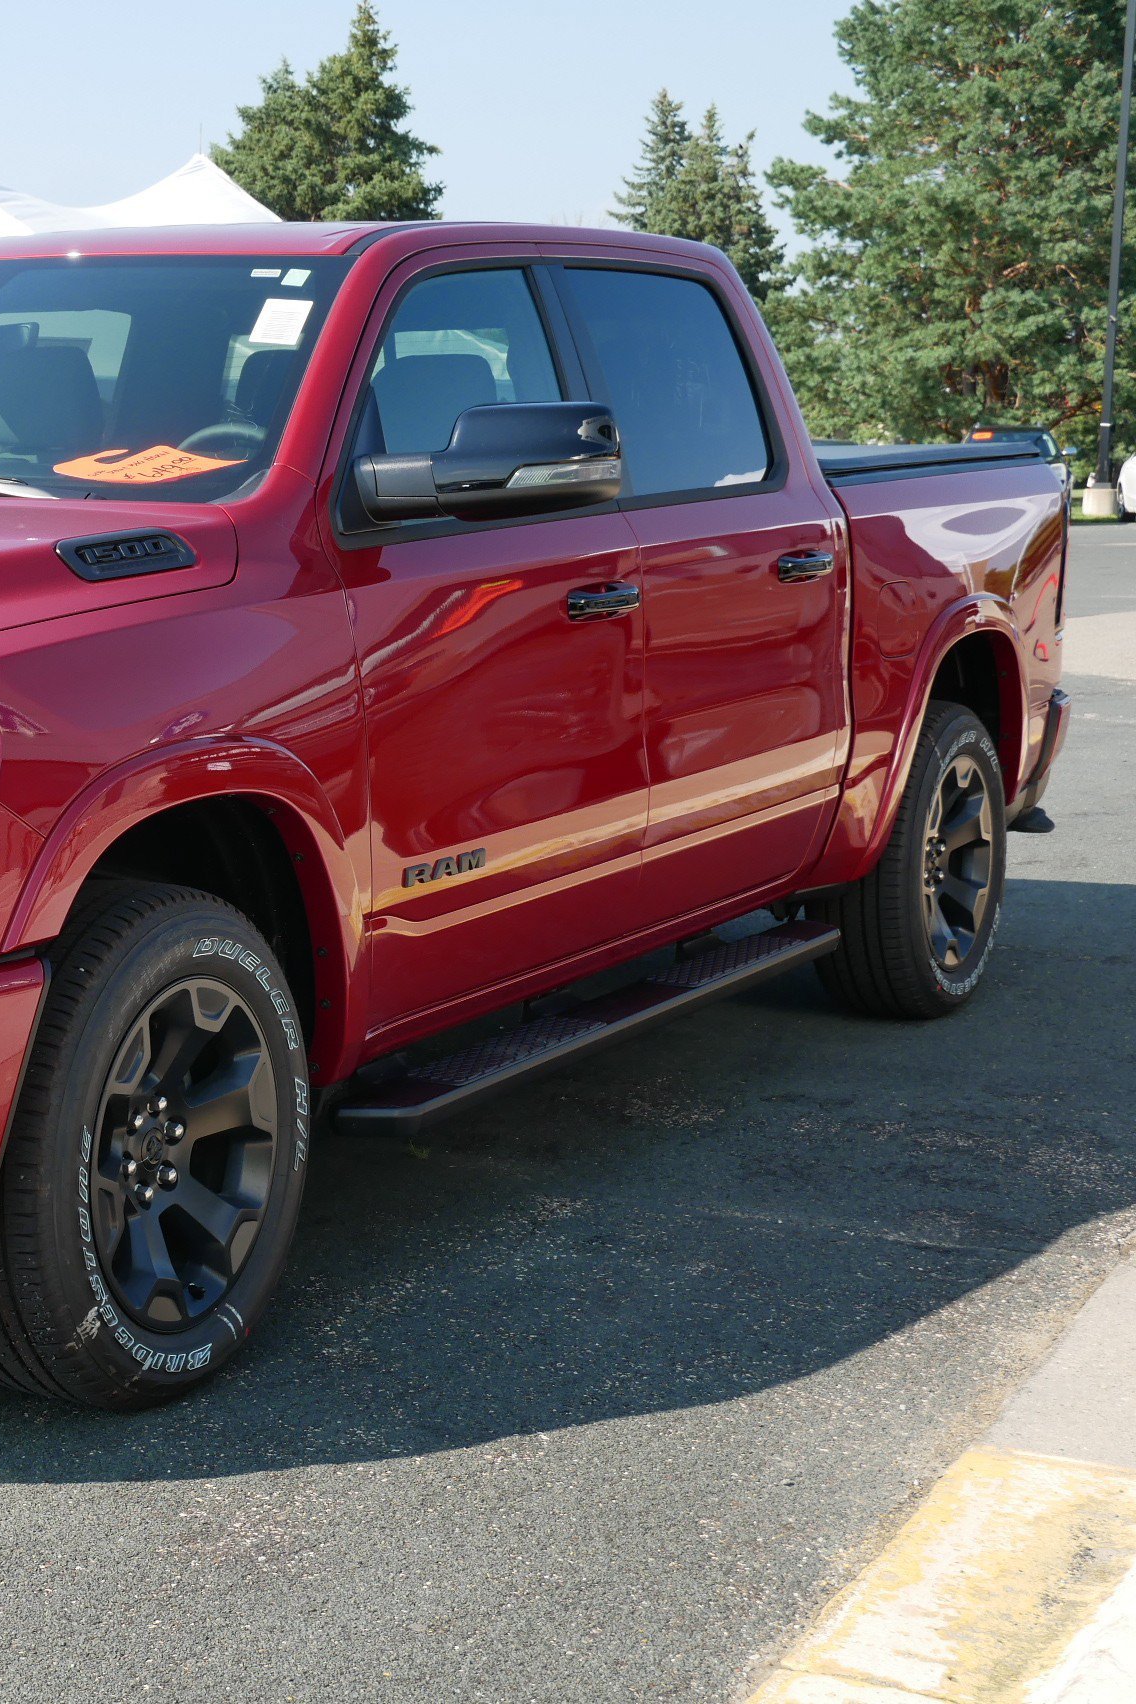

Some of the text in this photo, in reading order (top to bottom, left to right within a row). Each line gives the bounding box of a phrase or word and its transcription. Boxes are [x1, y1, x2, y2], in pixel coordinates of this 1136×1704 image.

[78, 539, 165, 564] 1500
[401, 847, 487, 889] RAM
[193, 937, 300, 1050] DUELER
[77, 1124, 213, 1373] BRIDGESTONE
